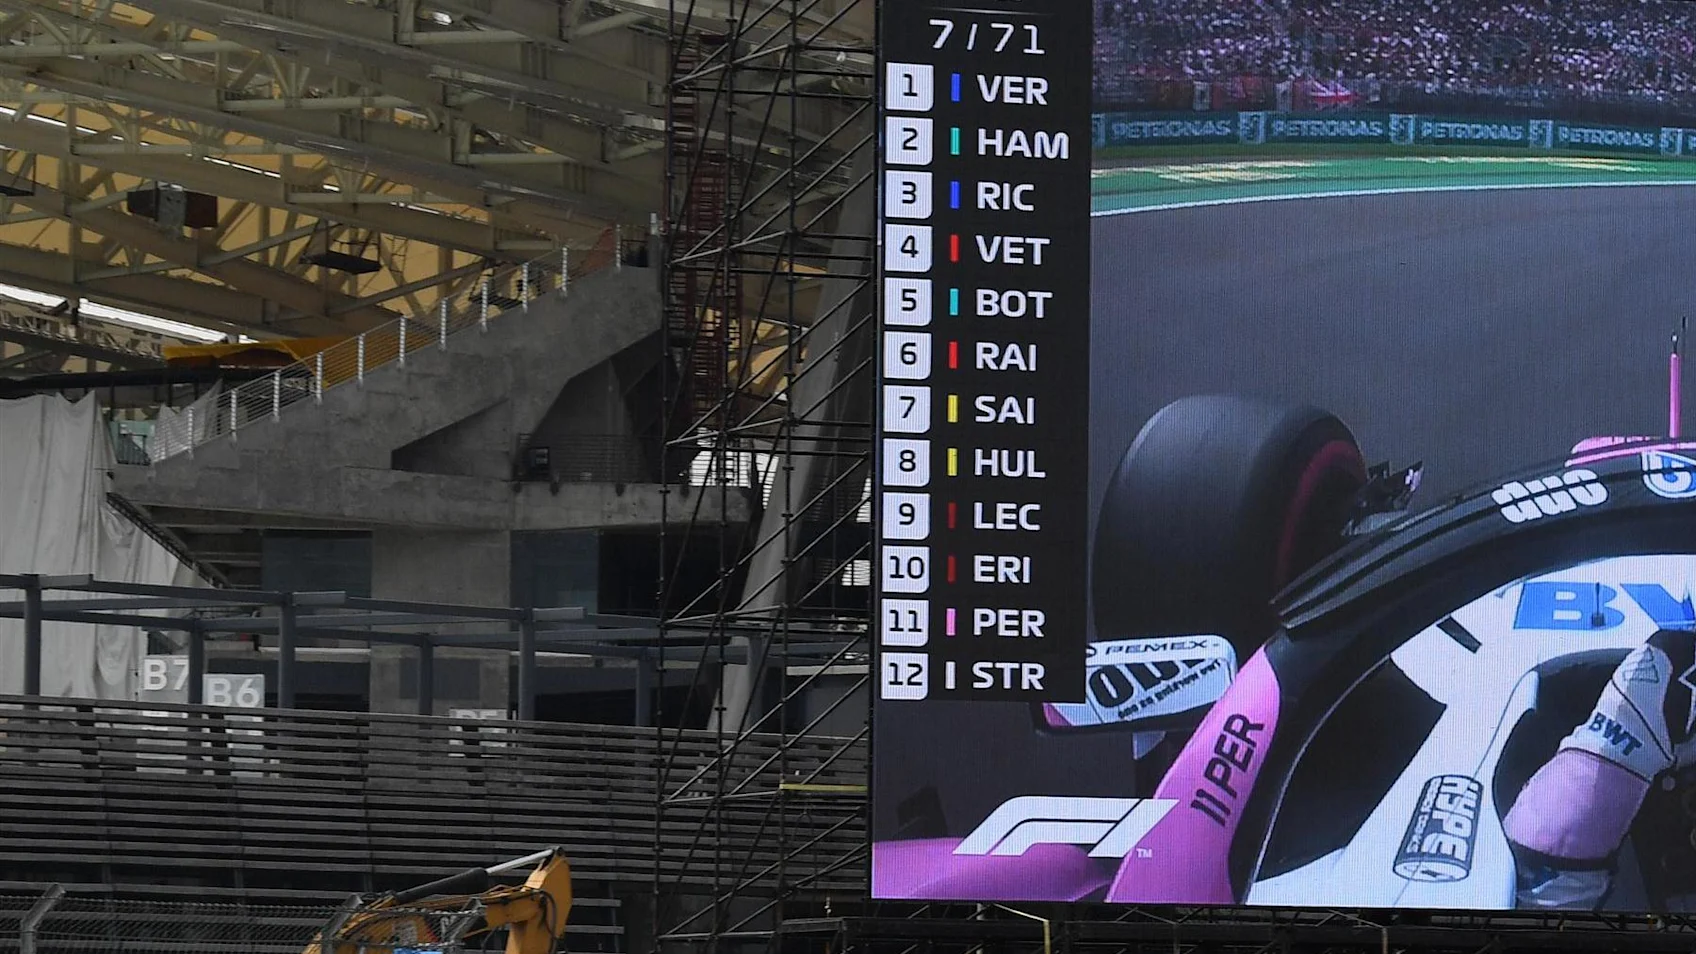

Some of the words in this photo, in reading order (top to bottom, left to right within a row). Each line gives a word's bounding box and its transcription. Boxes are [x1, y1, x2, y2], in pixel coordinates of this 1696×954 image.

[903, 73, 918, 97] 1
[976, 74, 1048, 105] VER
[902, 127, 918, 151] 2
[978, 128, 1069, 160] HAM
[901, 181, 917, 205] 3
[977, 181, 1034, 211] RIC
[900, 234, 919, 259] 4
[975, 235, 1050, 265] VET
[901, 288, 917, 312] 5
[976, 288, 1053, 319] BOT
[900, 342, 917, 366] 6
[976, 341, 1037, 372] RAI
[899, 395, 916, 419] 7
[975, 395, 1035, 425] SAI
[899, 449, 917, 473] 8
[974, 448, 1046, 478] HUL
[898, 502, 916, 526] 9
[974, 502, 1041, 531] LEC
[889, 555, 925, 580] 10
[974, 555, 1031, 584] ERI
[889, 609, 923, 633] 11
[973, 608, 1045, 638] PER
[1105, 639, 1208, 656] PEMEX
[143, 658, 190, 691] B7
[888, 662, 923, 687] 12
[972, 661, 1045, 690] STR
[206, 677, 261, 709] B6
[1587, 711, 1643, 757] BWT
[1203, 713, 1265, 799] PER
